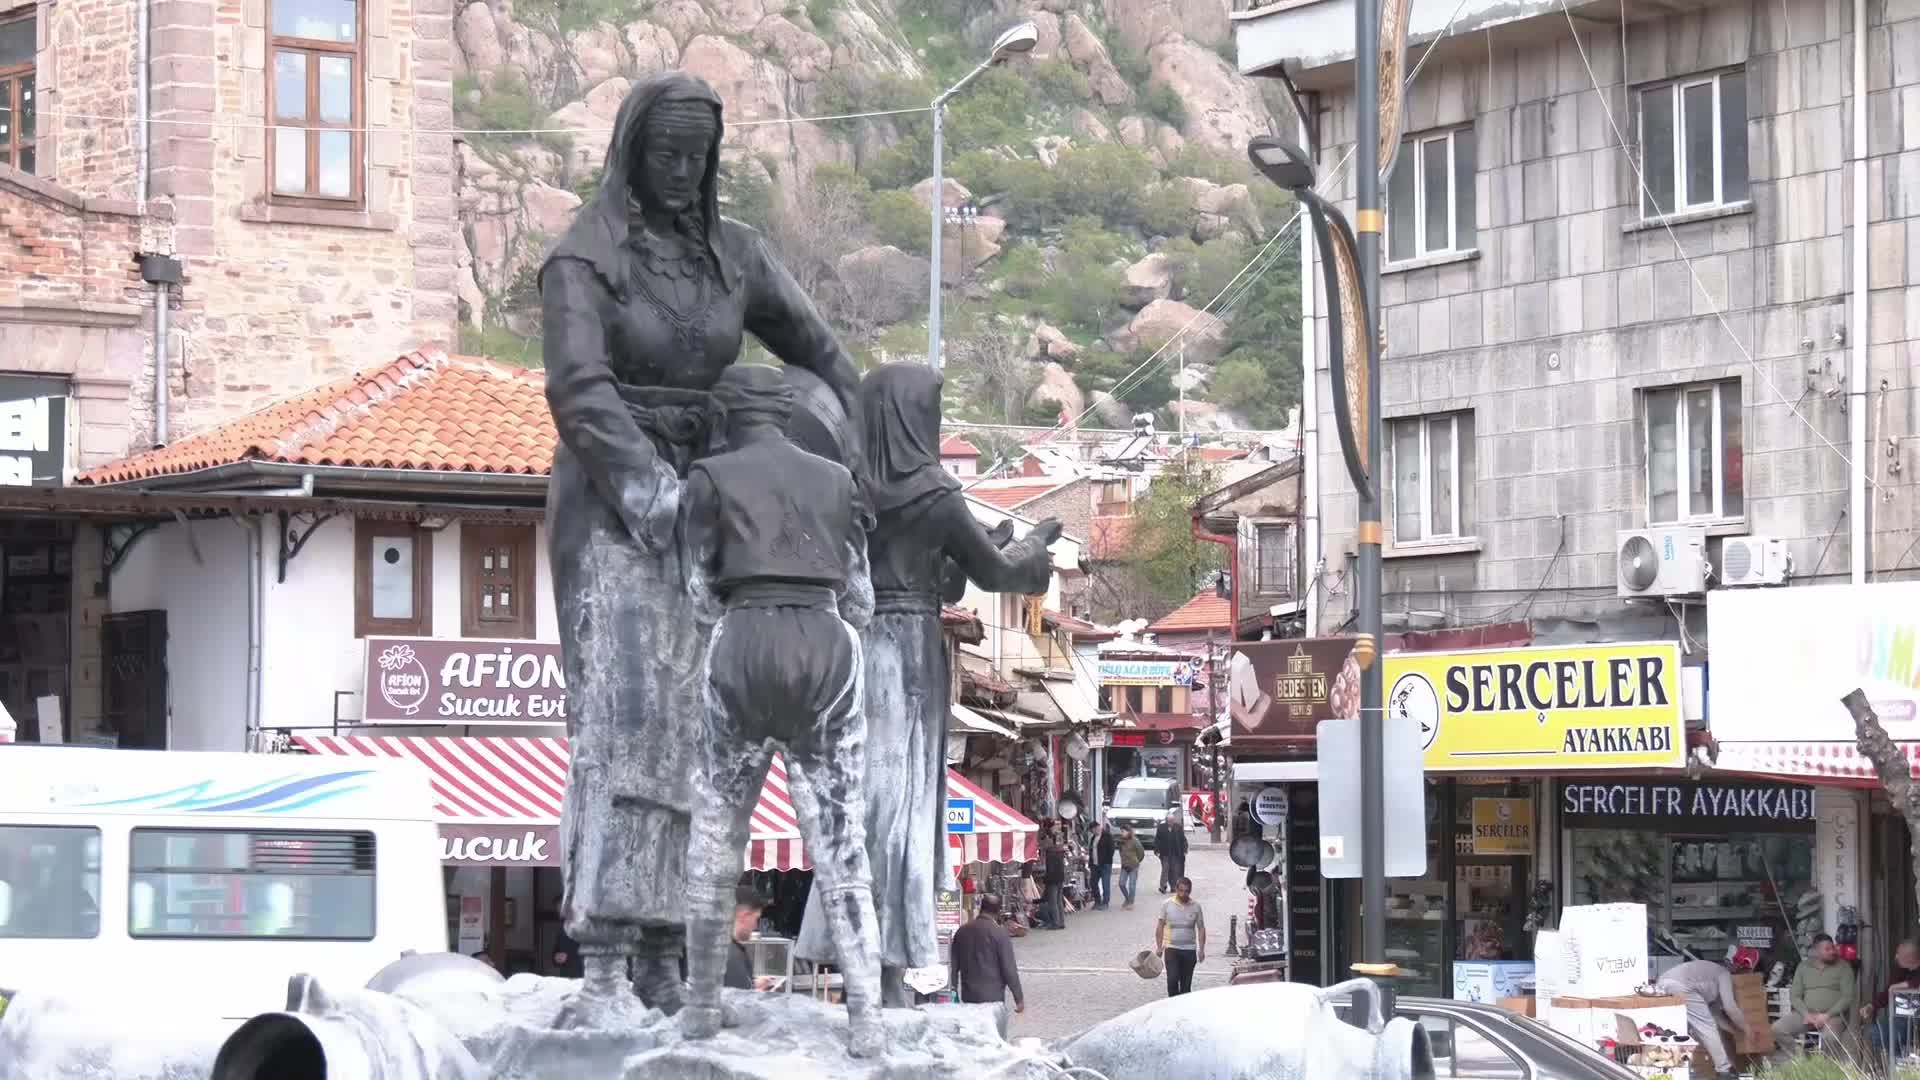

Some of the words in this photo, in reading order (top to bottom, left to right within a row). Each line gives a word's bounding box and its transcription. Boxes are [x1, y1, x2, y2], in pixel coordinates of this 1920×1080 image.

[388, 673, 421, 687] AFİON
[440, 647, 566, 688] AFİON
[1277, 678, 1325, 698] BEDESTEN
[1446, 657, 1669, 722] SERÇELER
[438, 692, 521, 717] Sucuk
[527, 694, 567, 717] Evi
[1563, 726, 1671, 752] AYAKKABI
[1691, 787, 1816, 819] AYAKKABI
[438, 832, 549, 861] ucuk
